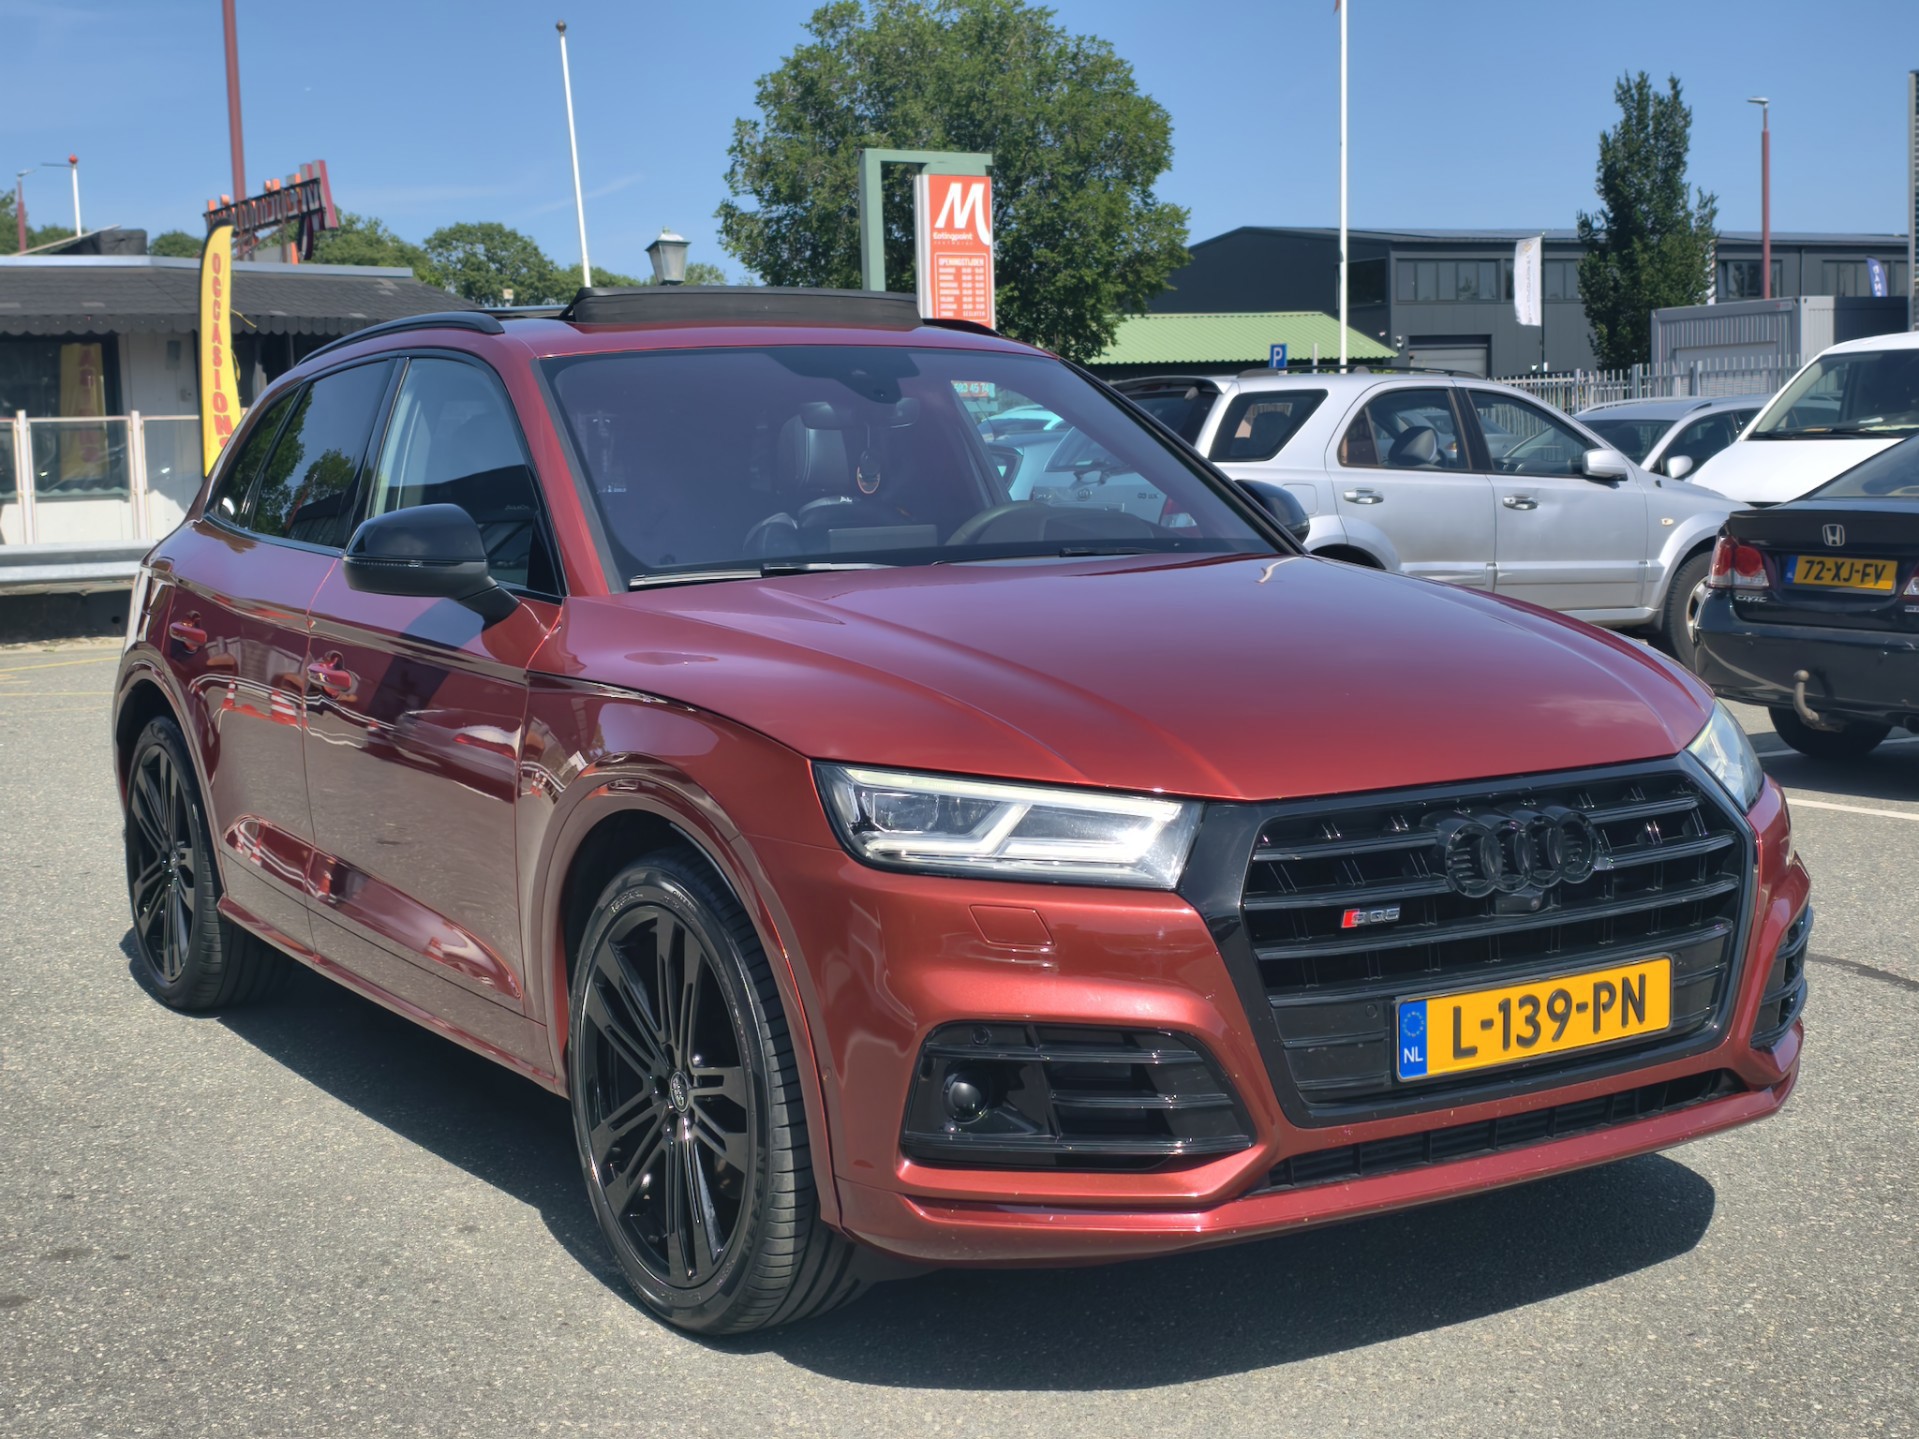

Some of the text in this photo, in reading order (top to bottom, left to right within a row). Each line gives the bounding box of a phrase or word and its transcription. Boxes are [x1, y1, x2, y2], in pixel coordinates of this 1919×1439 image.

[212, 253, 235, 448] OCCASION
[1273, 347, 1283, 367] P
[1803, 560, 1887, 586] 72-XJ-FV
[1452, 973, 1647, 1061] L-139-PN
[1403, 1046, 1424, 1064] NL
